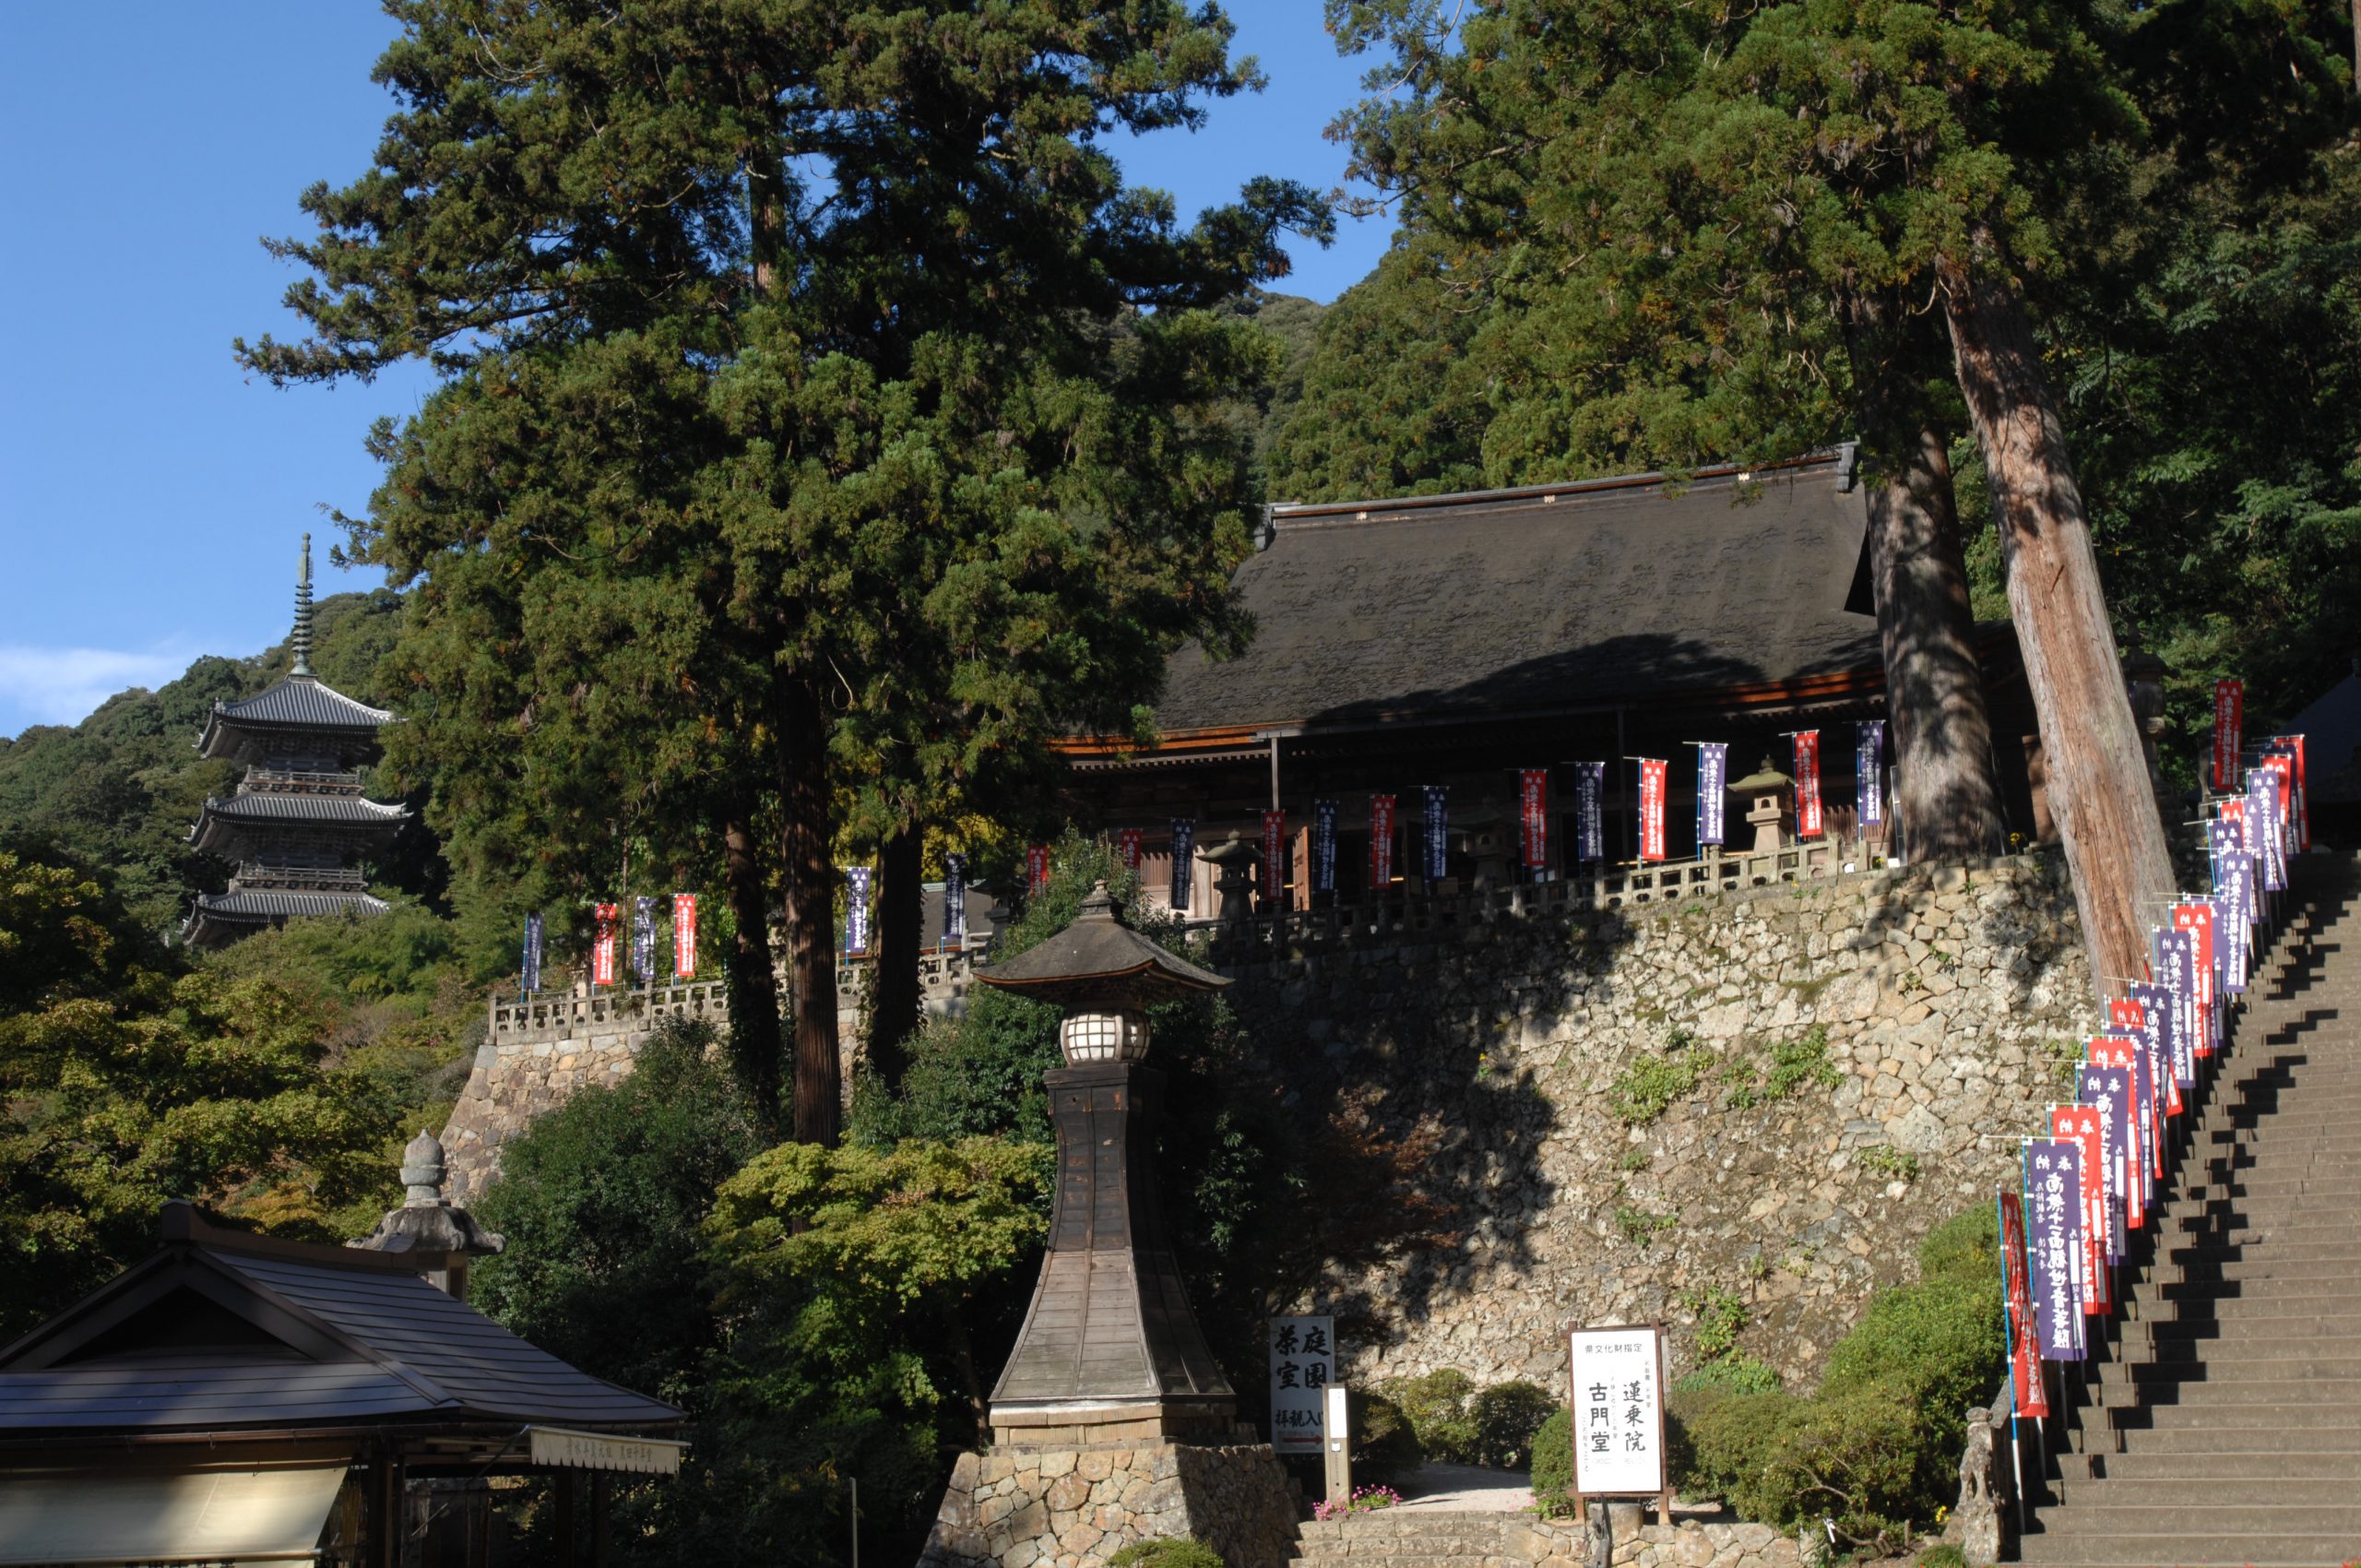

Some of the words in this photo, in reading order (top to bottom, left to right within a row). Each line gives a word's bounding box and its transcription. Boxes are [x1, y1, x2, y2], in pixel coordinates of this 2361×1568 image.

[1275, 1324, 1300, 1390] 茶室
[1301, 1325, 1330, 1389] 庭園
[1584, 1343, 1643, 1354] 県文化財指定
[1589, 1383, 1609, 1453] 古門堂
